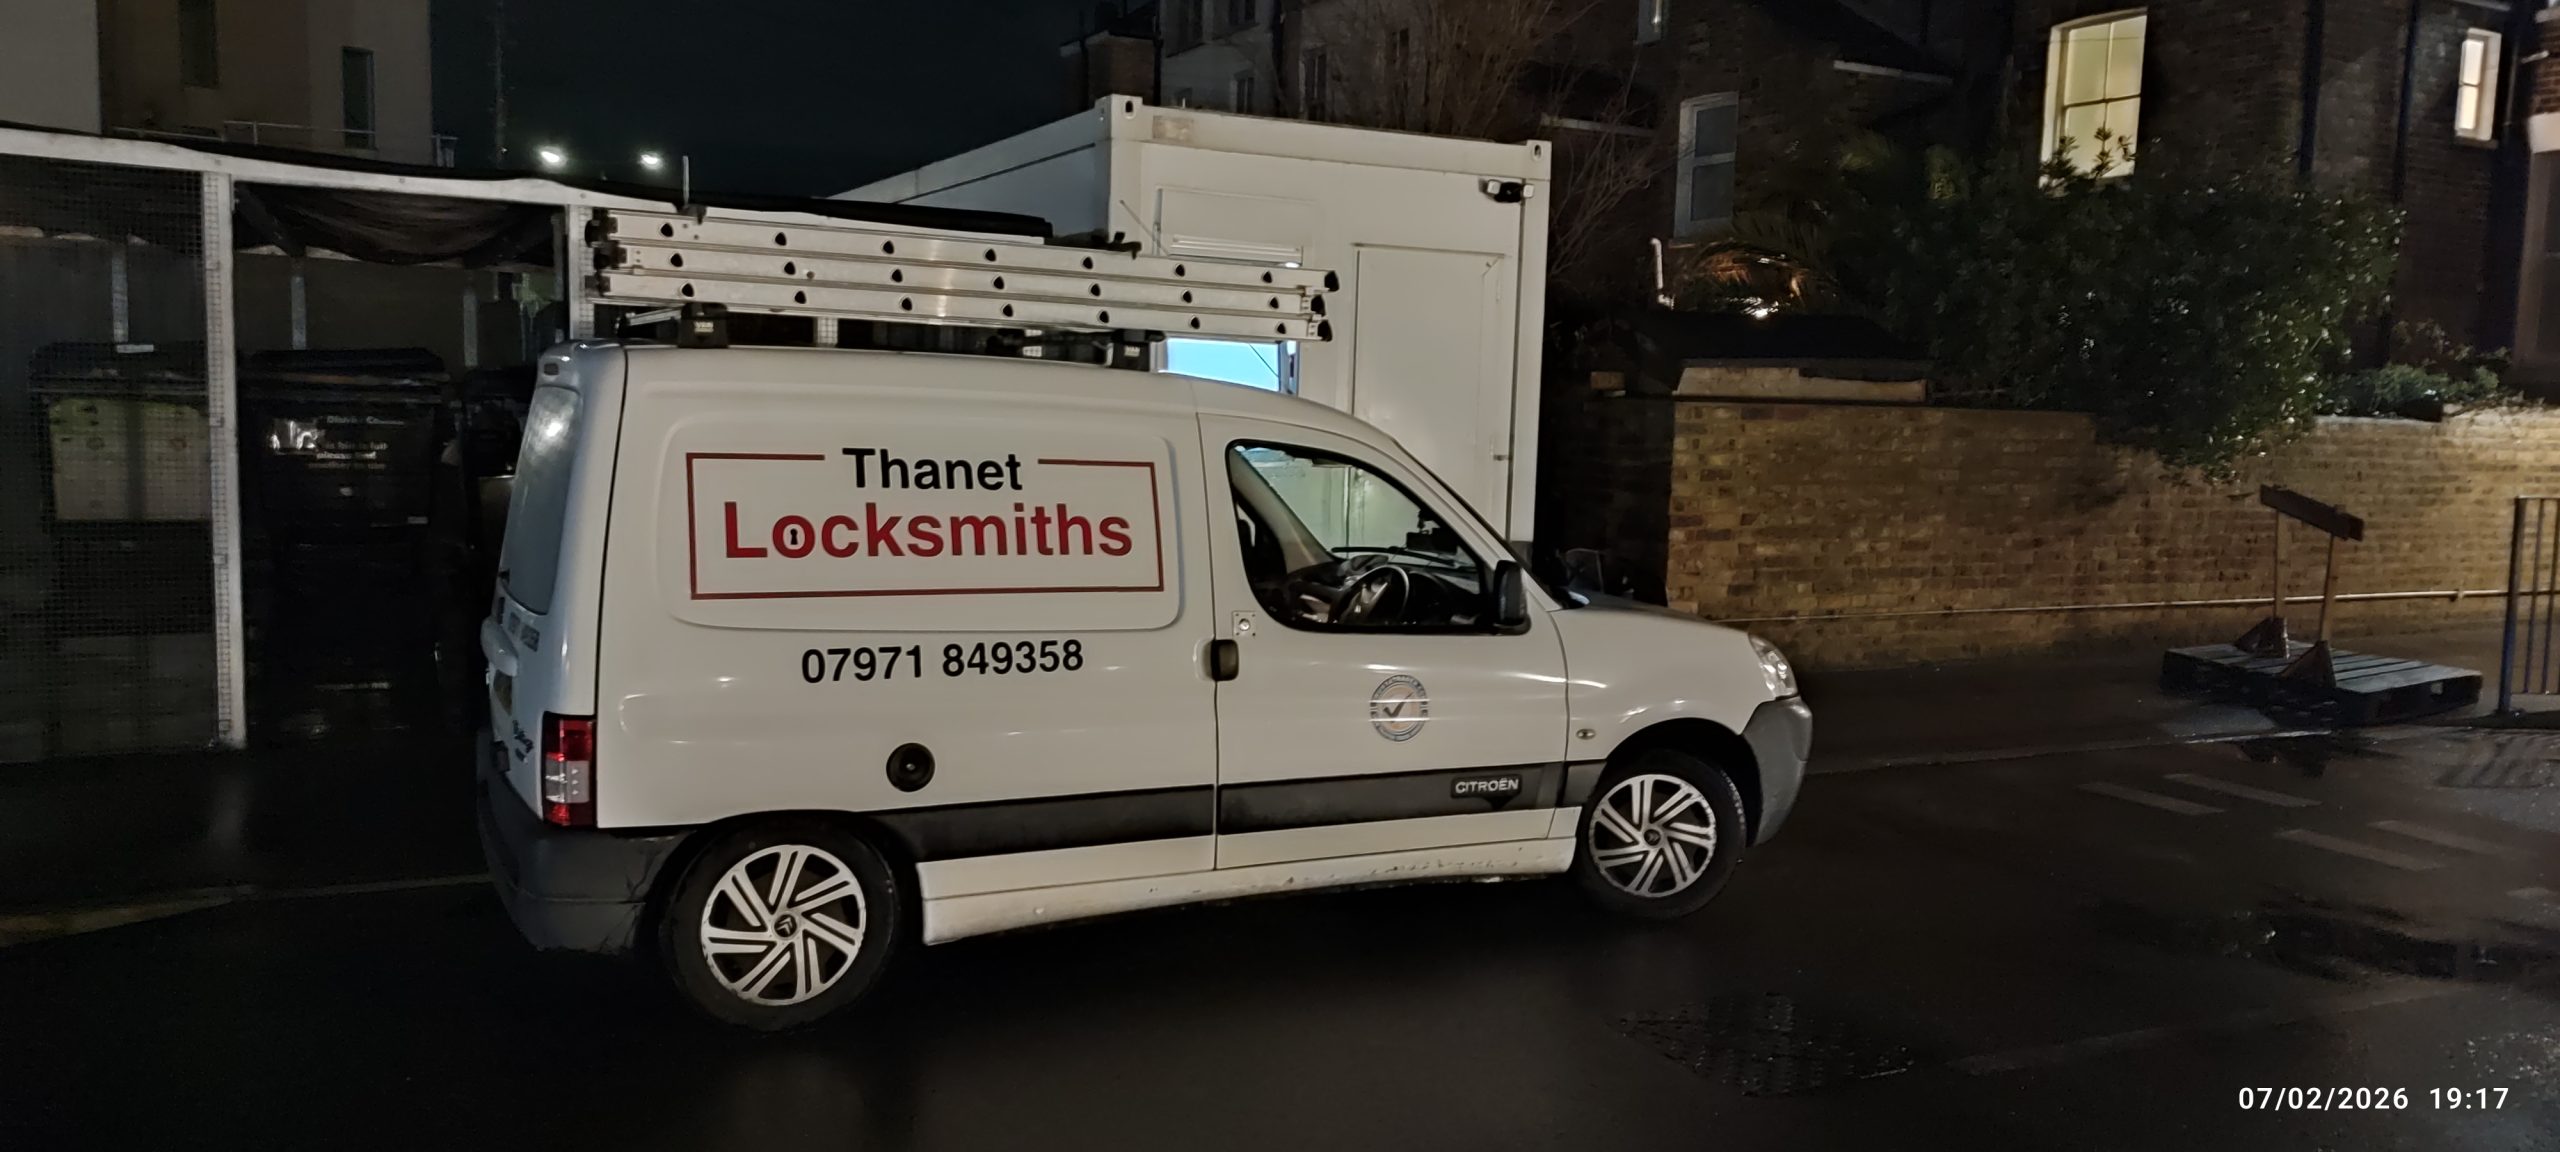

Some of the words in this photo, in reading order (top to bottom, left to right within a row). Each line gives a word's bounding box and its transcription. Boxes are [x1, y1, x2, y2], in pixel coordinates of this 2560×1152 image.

[841, 447, 1022, 491] Thanet
[724, 501, 1133, 559] Locksmiths
[801, 645, 922, 684] 07971
[942, 639, 1084, 677] 849358
[1455, 778, 1519, 794] CITROËN
